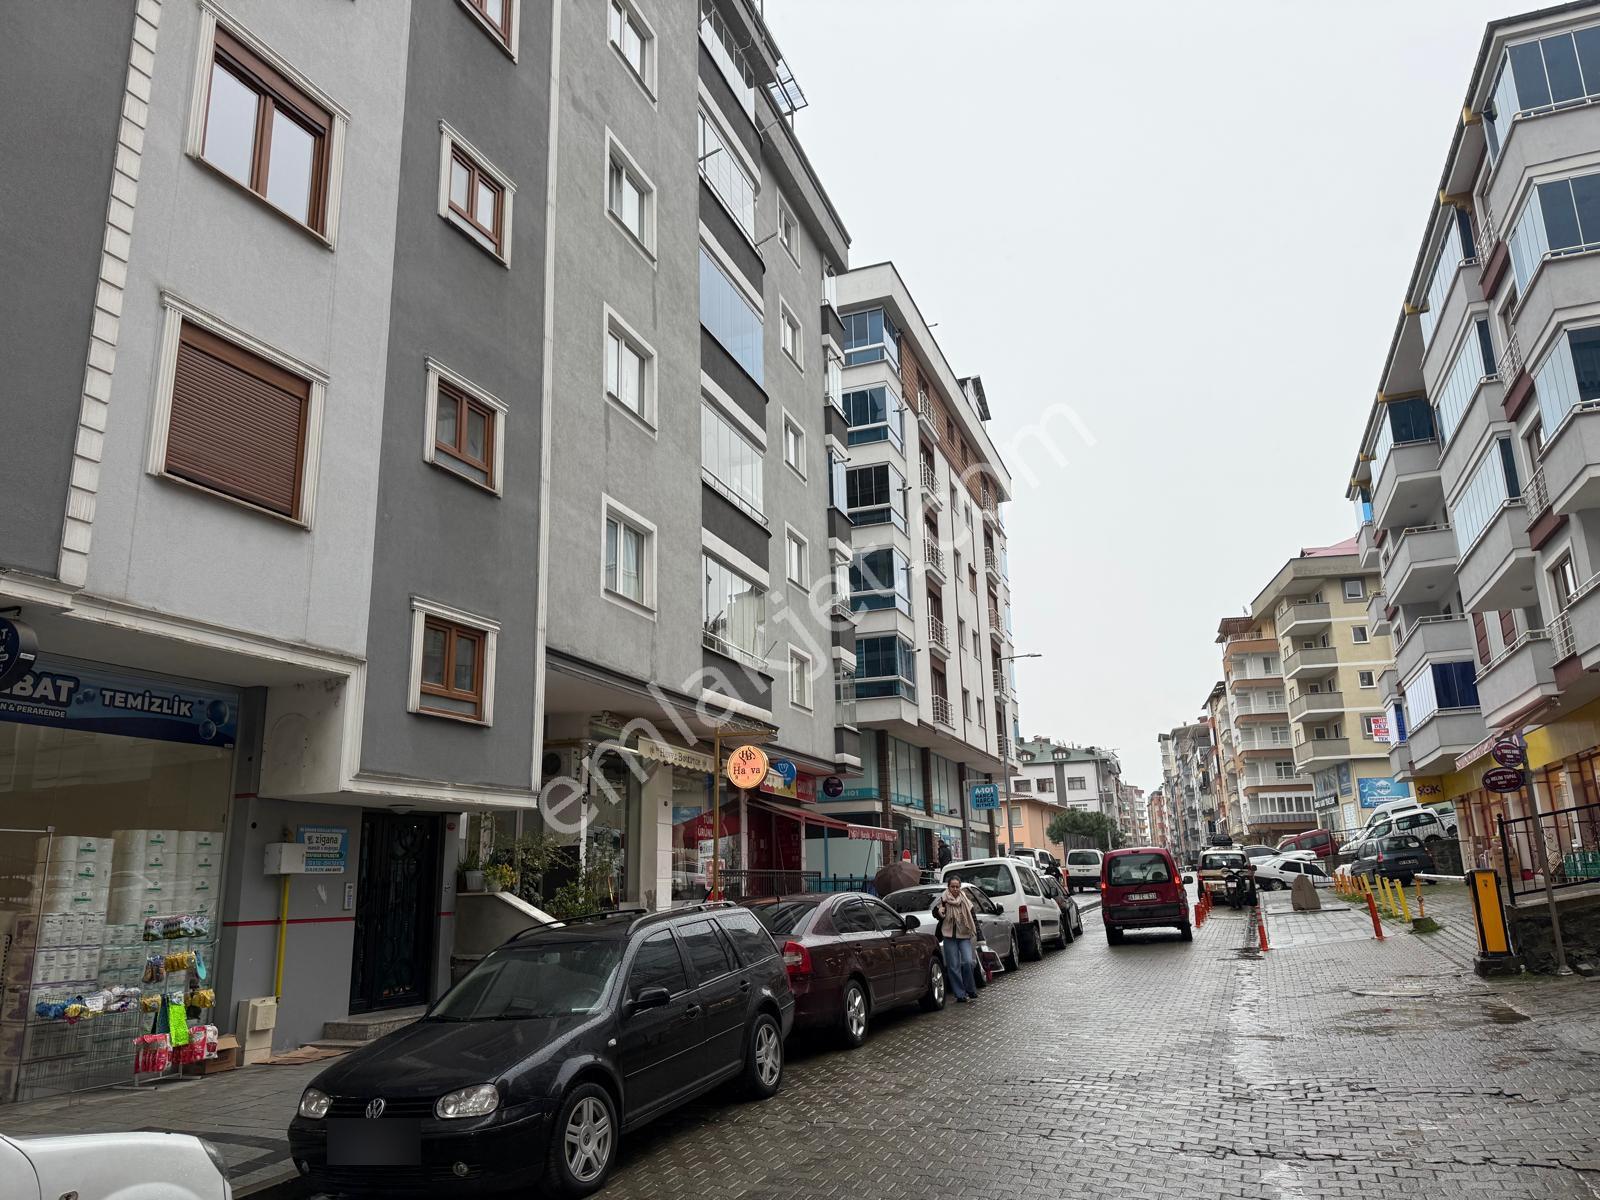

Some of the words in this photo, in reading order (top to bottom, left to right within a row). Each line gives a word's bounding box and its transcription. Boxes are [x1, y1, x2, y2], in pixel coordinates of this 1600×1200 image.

[0, 674, 75, 702] BAT
[101, 690, 193, 717] TEMİZLİK
[16, 705, 66, 718] PERAKENDE
[315, 834, 338, 846] zigana
